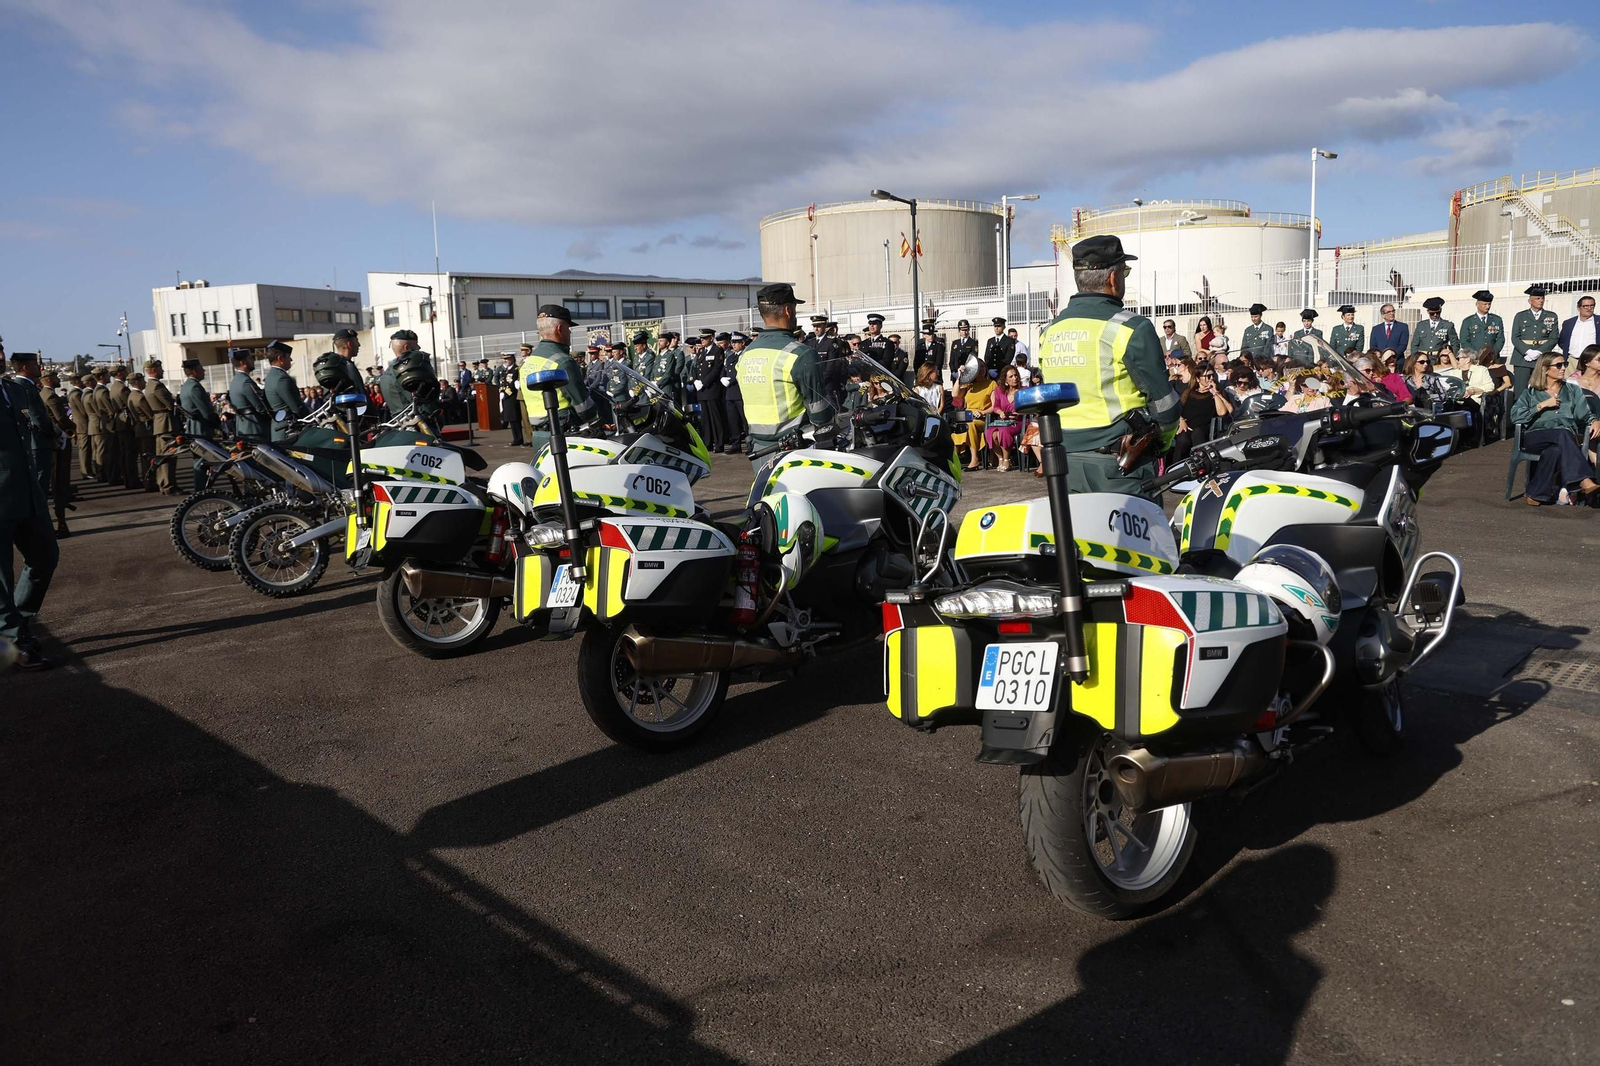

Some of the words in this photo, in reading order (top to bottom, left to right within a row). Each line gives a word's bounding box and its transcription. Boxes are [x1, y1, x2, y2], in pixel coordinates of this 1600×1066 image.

[1048, 331, 1088, 342] GUARDIA
[1053, 342, 1075, 353] CIVIL
[1045, 355, 1086, 366] TRAFICO
[421, 454, 443, 470] 062
[645, 476, 671, 497] 062
[1122, 511, 1151, 541] 062
[555, 586, 578, 603] 0324
[1206, 649, 1223, 657] BMW
[985, 670, 993, 680] E
[994, 679, 1046, 705] 0310
